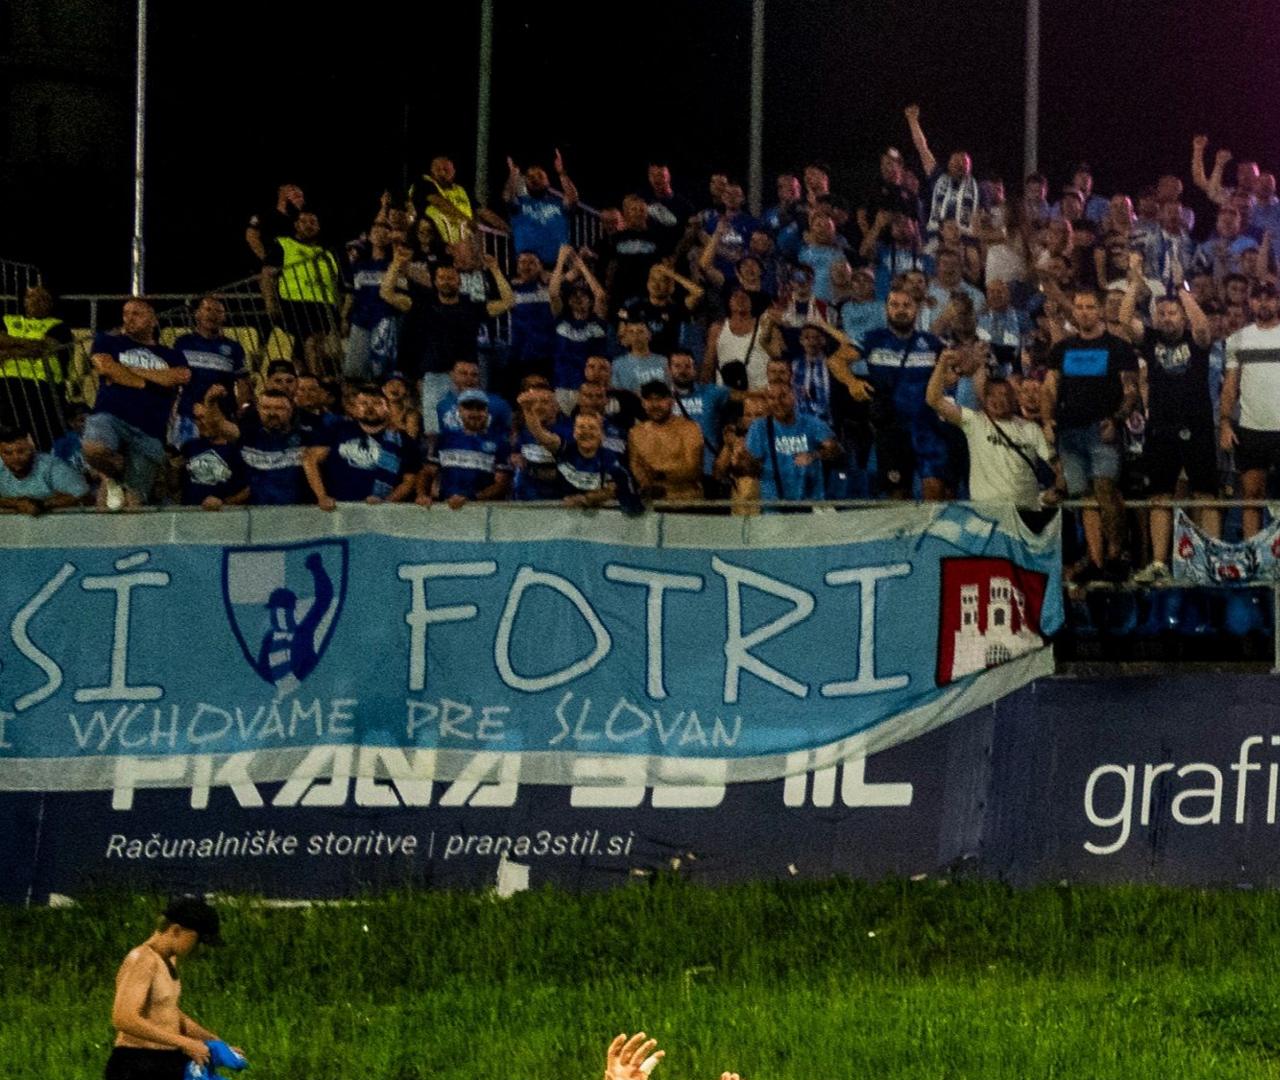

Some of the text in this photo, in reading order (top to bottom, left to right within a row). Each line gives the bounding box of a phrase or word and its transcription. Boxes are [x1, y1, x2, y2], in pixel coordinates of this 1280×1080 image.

[397, 553, 913, 703] FOTRI
[406, 699, 512, 743] PRE
[549, 691, 742, 748] SLOVAN
[104, 829, 636, 863] Računalniške storitve prana3stil.si
